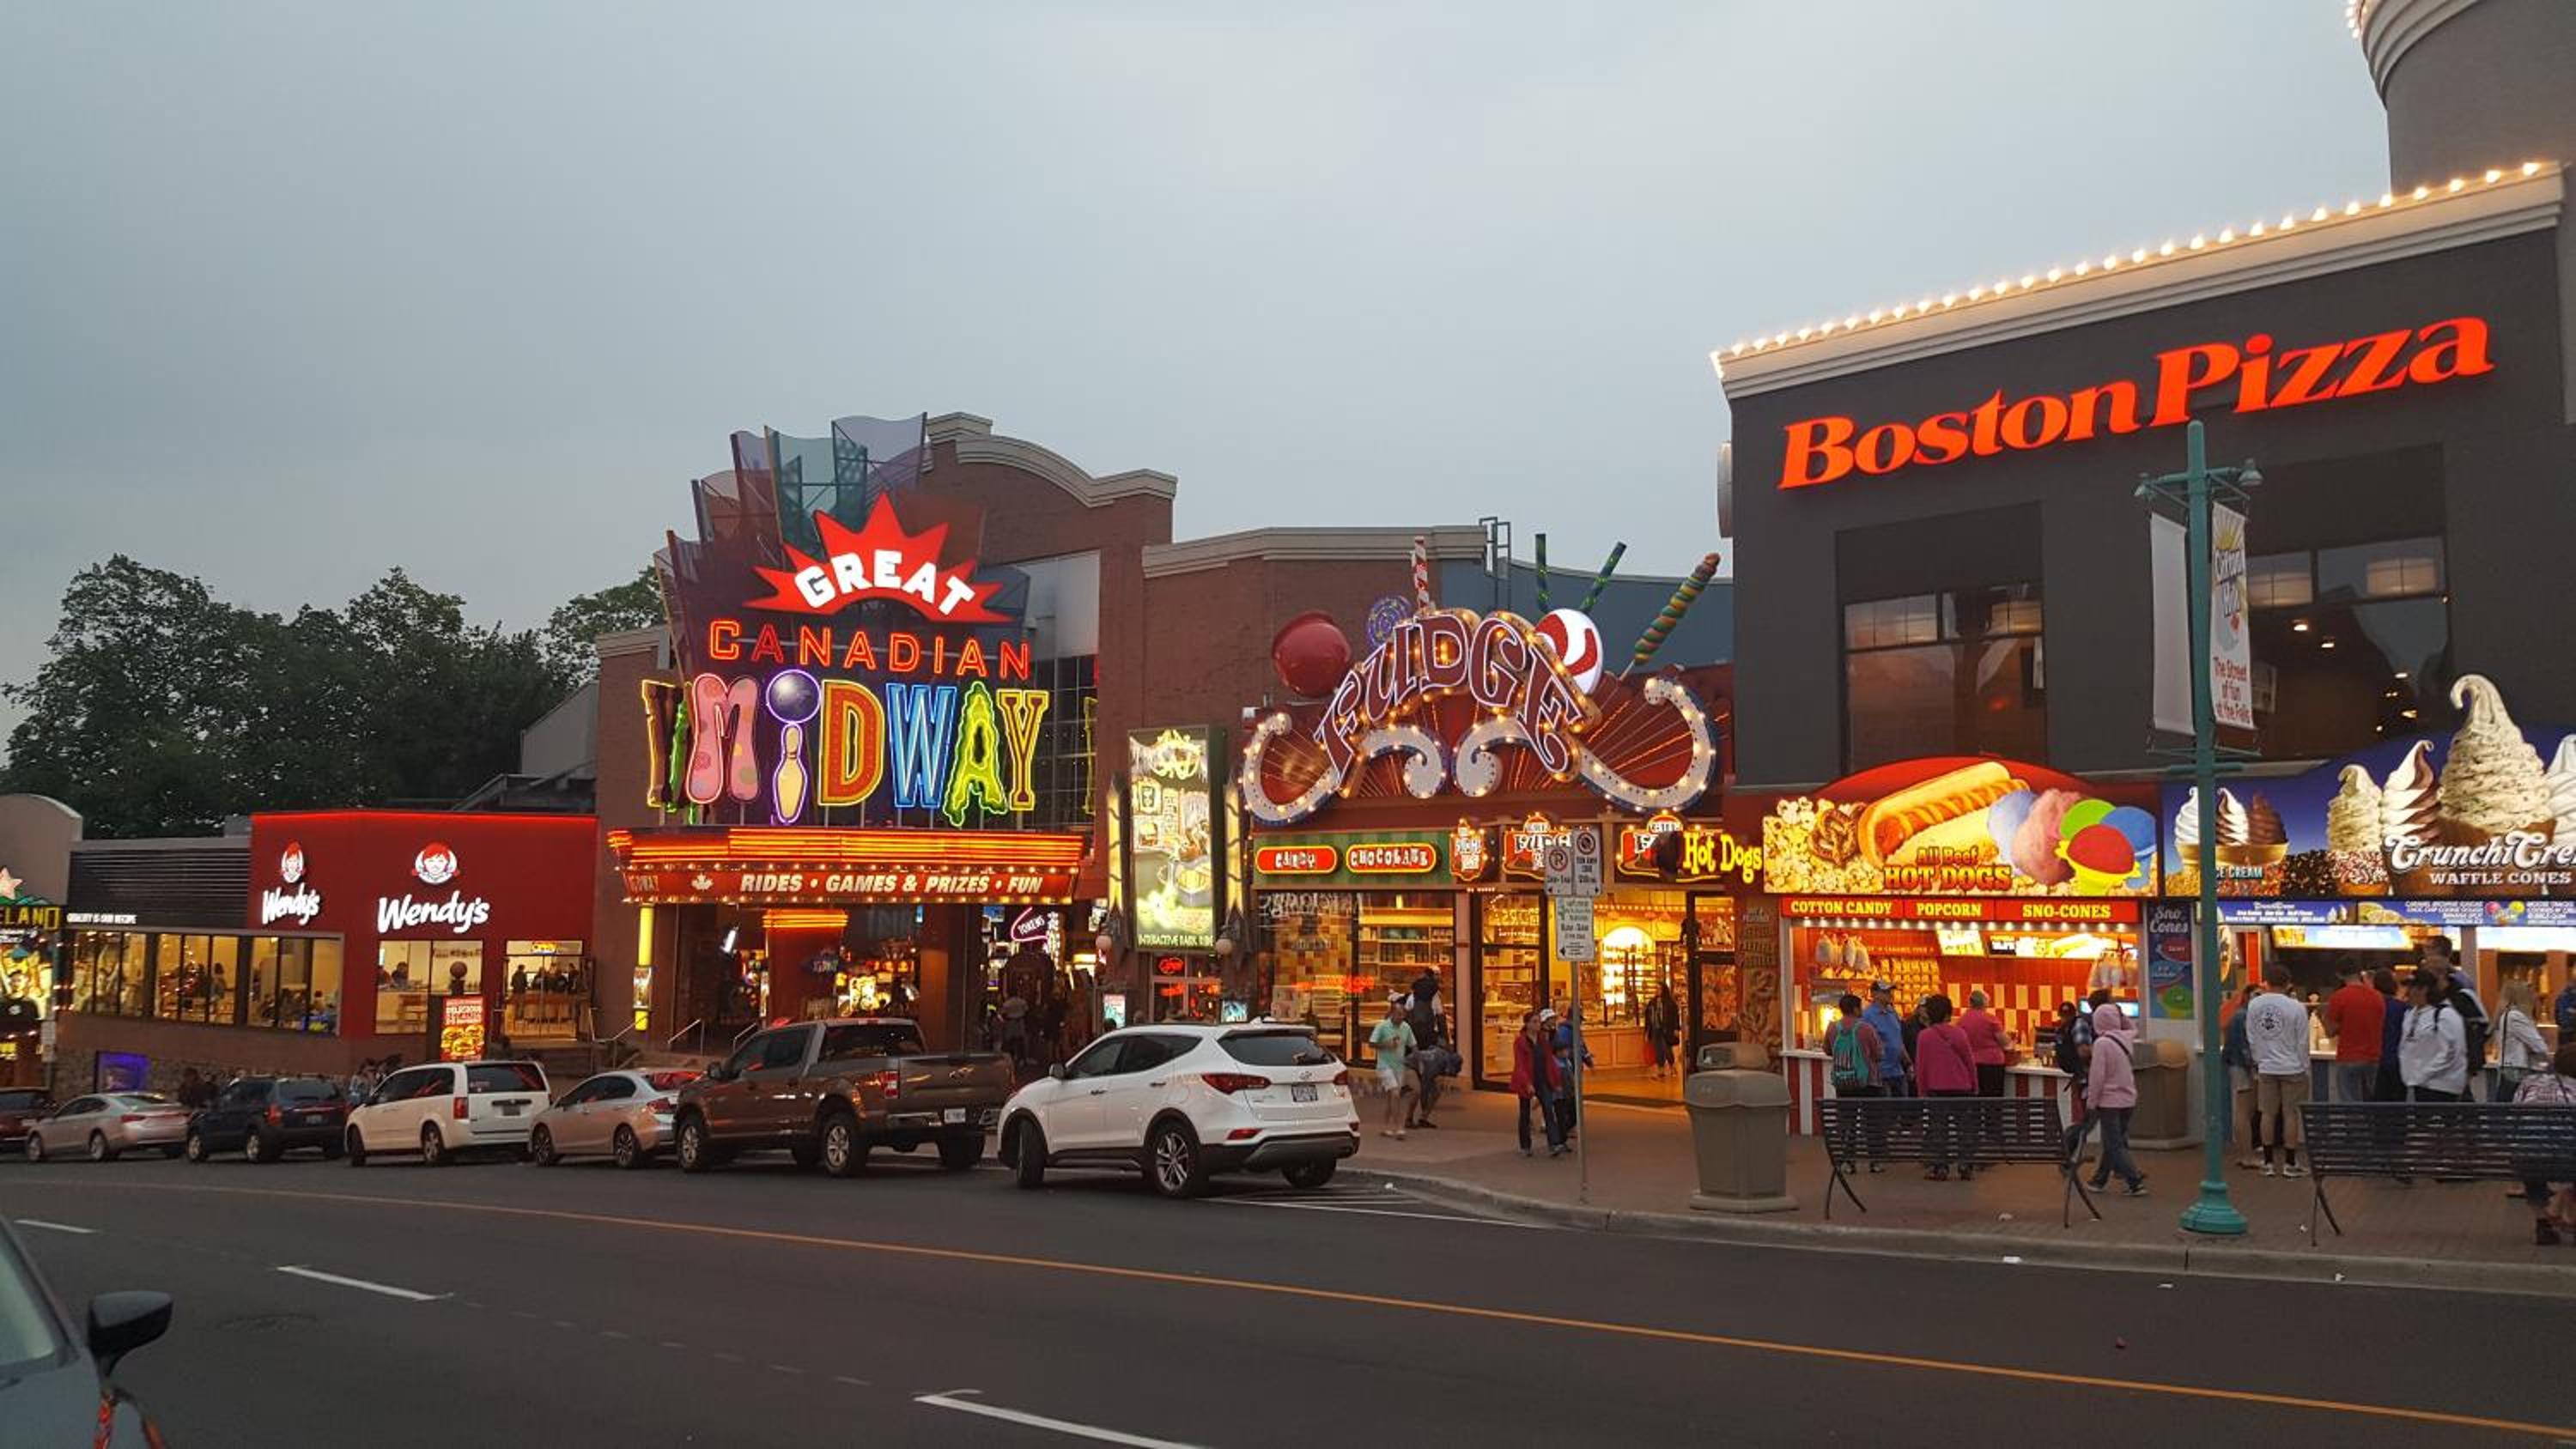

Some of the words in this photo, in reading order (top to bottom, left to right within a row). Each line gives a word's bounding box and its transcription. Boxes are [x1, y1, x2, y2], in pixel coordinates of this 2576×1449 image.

[1777, 381, 2142, 489] Boston
[2152, 315, 2494, 427] Pizza
[793, 549, 975, 615] GREAT
[709, 619, 1030, 680] CANADIAN
[1682, 831, 1716, 875] Hot
[1720, 834, 1763, 884] Dogs
[1916, 846, 1940, 866] All
[1941, 845, 1979, 866] Beef
[2385, 830, 2576, 870] CrunchiCre
[1883, 864, 1935, 891] HOT
[1939, 864, 2013, 891] DOGS
[2228, 866, 2263, 878] CREAM
[2429, 870, 2504, 885] WAFFLE
[2507, 870, 2572, 884] CONES
[740, 874, 803, 893] RIDES
[825, 874, 896, 893] GAMES
[902, 874, 917, 893] &
[924, 875, 990, 894] PRIZES
[1006, 876, 1043, 894] FUN
[261, 882, 320, 926] Wendy's
[377, 889, 490, 934] Wendy's
[1790, 901, 1844, 915] COTTON
[1846, 901, 1893, 915] CANDY
[1916, 902, 1982, 918] POPCORN
[2022, 904, 2111, 919] SNO-CONES
[2155, 906, 2181, 920] Sno
[2149, 919, 2189, 934] Cones
